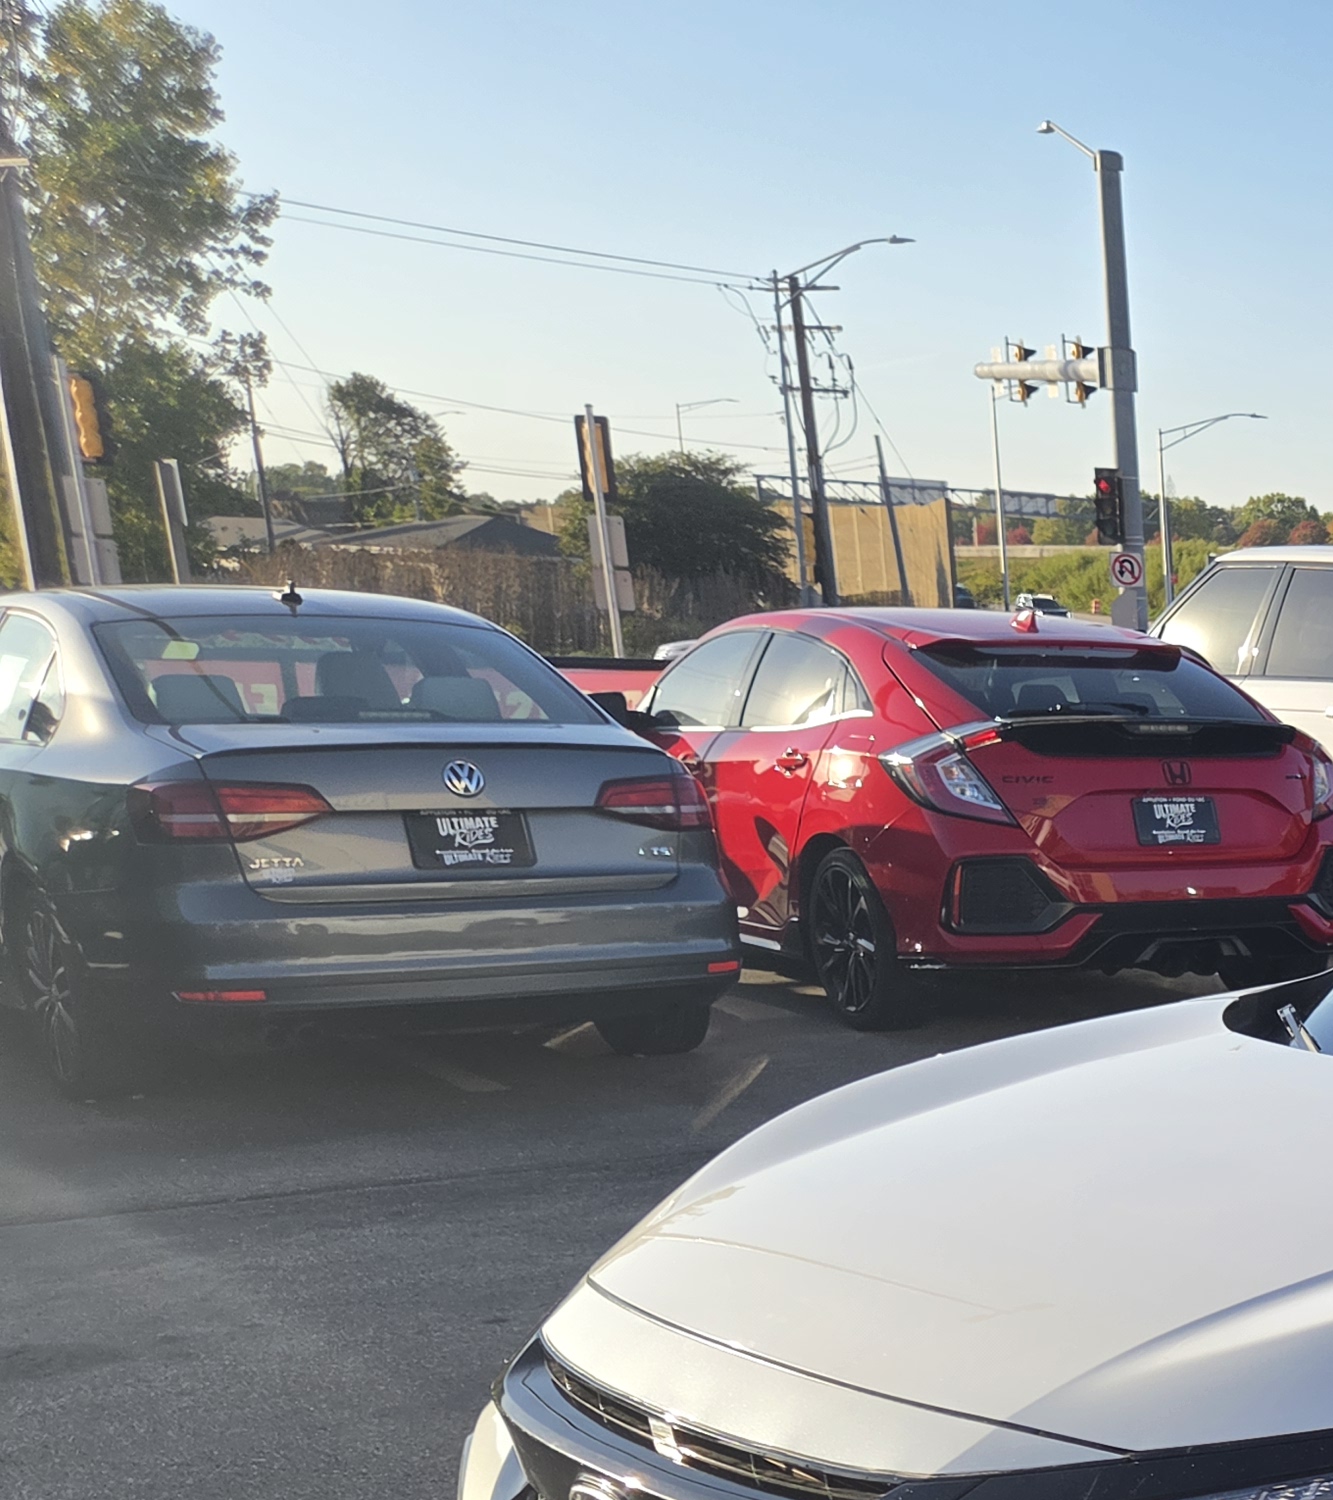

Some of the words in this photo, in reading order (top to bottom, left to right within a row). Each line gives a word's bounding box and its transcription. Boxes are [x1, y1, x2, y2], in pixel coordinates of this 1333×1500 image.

[1002, 775, 1054, 783] CIVIC
[1153, 803, 1197, 819] ULTIMATE
[436, 816, 499, 837] ULTIMATE
[454, 828, 495, 848] RIDES
[249, 857, 304, 869] JETTA
